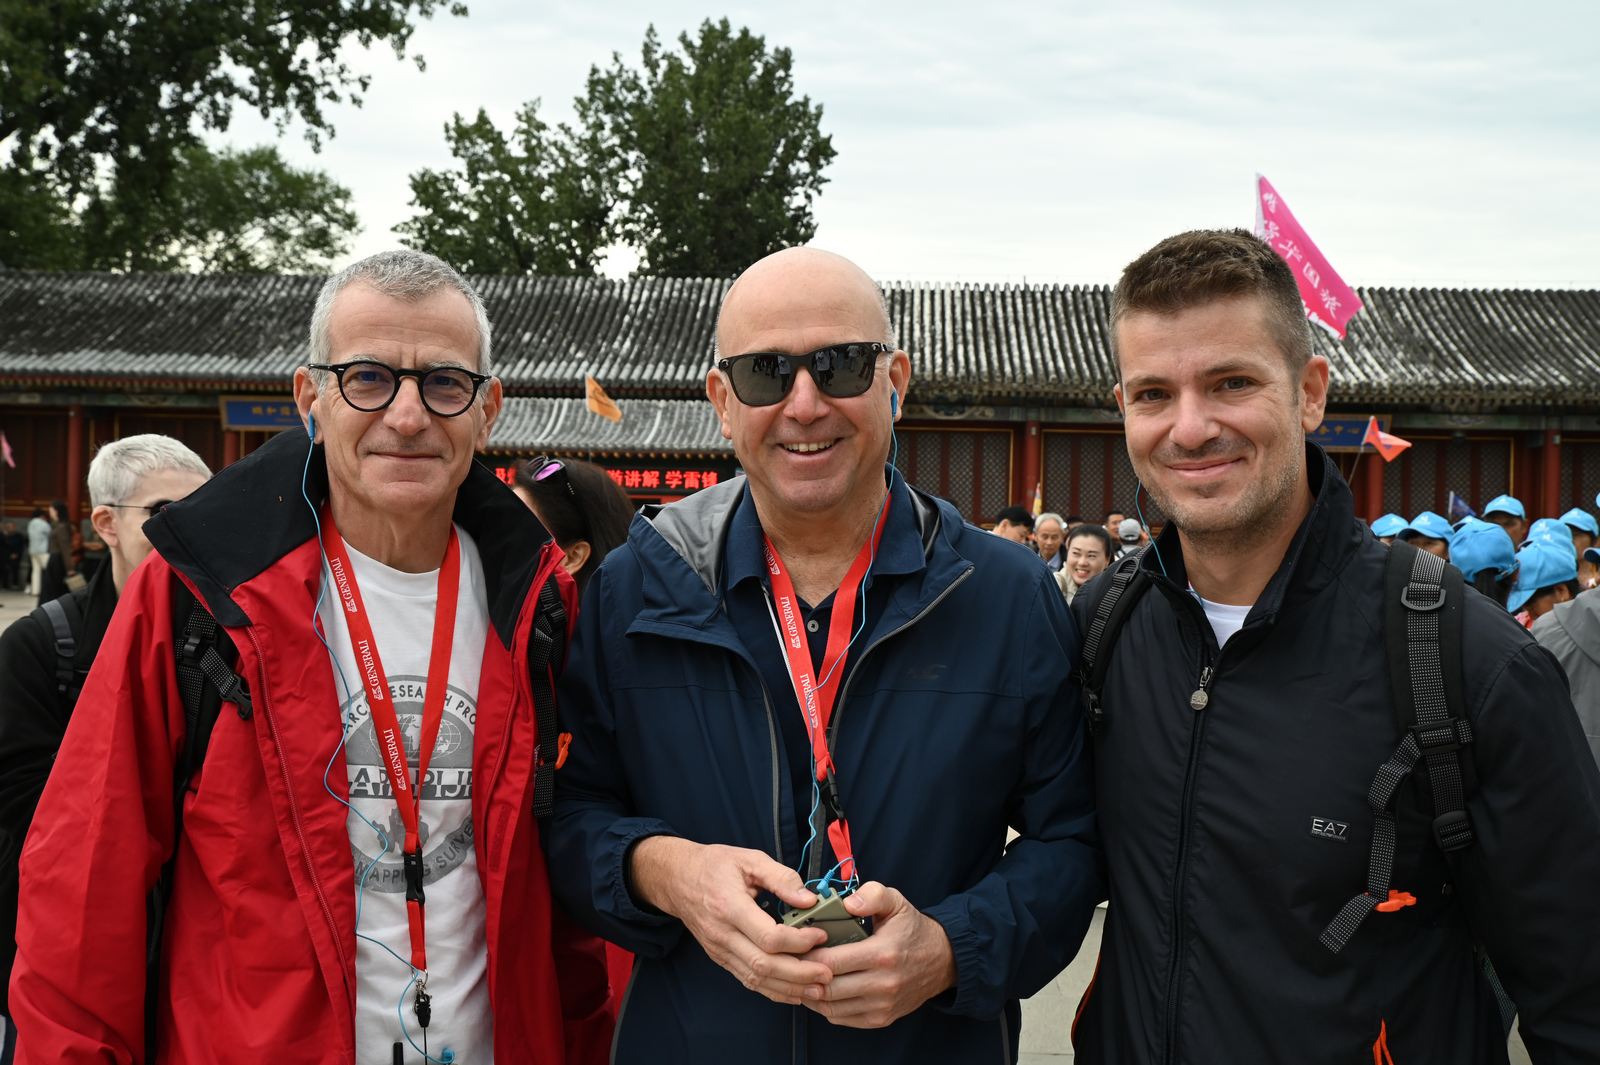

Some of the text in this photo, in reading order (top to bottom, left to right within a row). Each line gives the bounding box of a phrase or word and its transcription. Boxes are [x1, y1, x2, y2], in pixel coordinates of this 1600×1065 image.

[665, 470, 718, 489] 学雷锋
[330, 557, 353, 600] GENERALI
[780, 596, 798, 637] GENERALI
[358, 639, 380, 687] GENERALI
[383, 728, 404, 776] GENERALI
[1312, 818, 1348, 836] EA7
